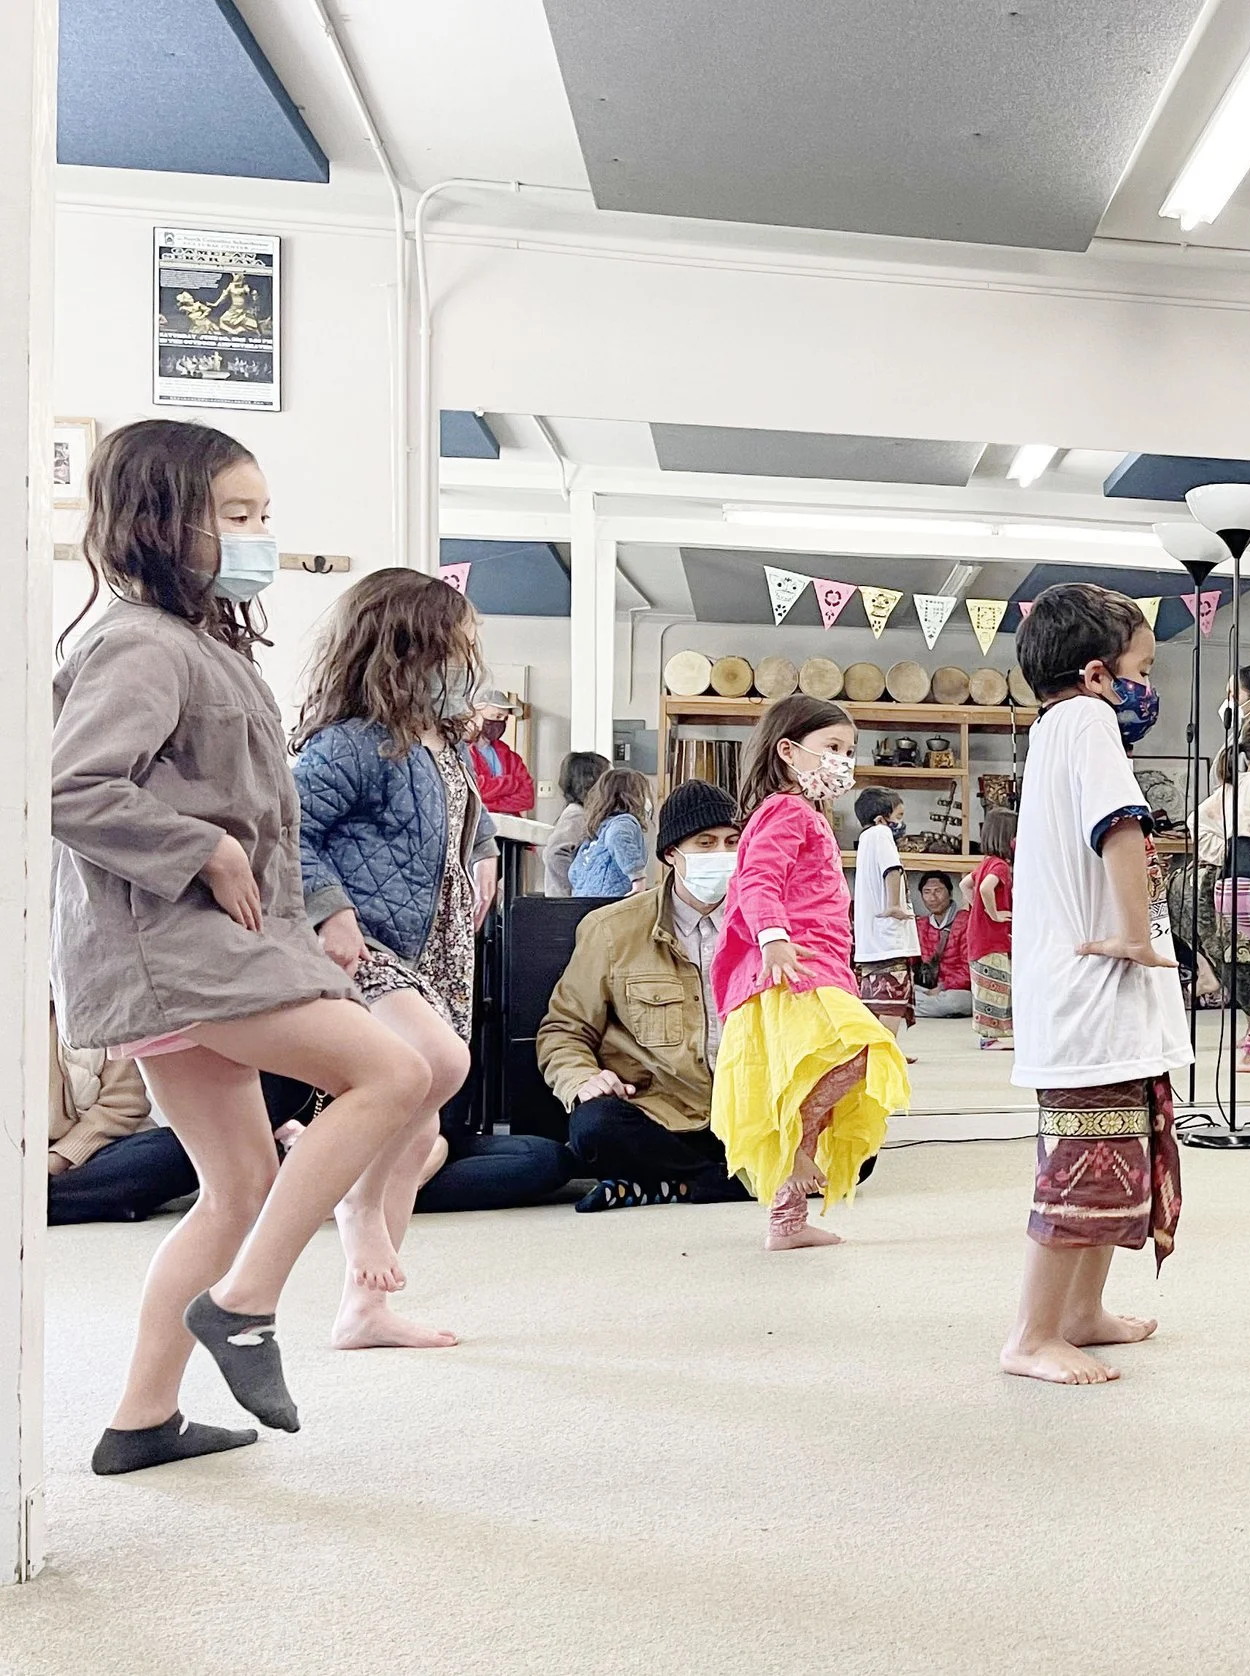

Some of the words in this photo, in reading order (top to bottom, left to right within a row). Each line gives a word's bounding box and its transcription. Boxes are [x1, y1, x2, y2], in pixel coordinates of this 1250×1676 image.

[161, 252, 220, 264] SEKAR
[222, 257, 267, 269] JAYA
[171, 247, 257, 261] GAMELAN
